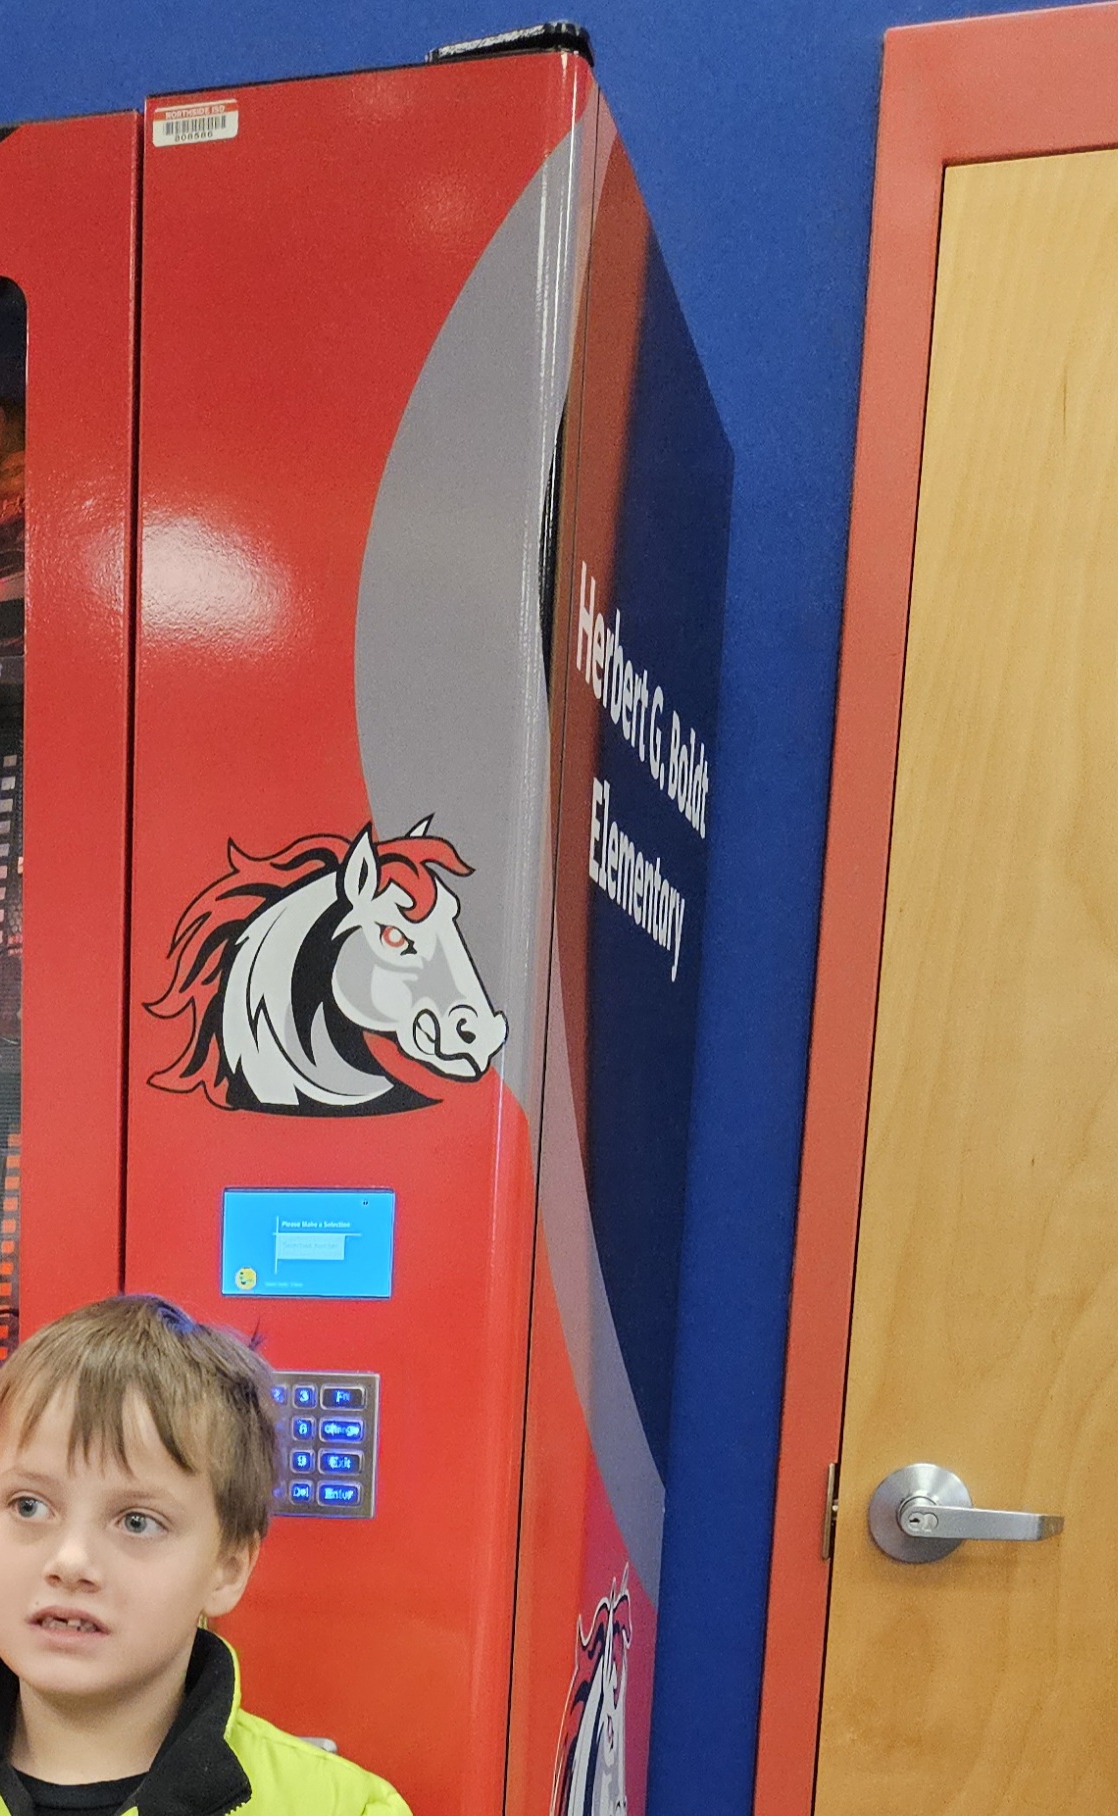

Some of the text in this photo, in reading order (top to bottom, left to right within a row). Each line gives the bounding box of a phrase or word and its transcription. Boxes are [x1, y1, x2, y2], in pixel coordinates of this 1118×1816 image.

[165, 105, 226, 119] NORTHSIDE ISD
[576, 561, 709, 839] Herbert G. Boldt
[589, 777, 685, 983] Elementary
[299, 1390, 310, 1402] 3
[293, 1486, 309, 1498] Del
